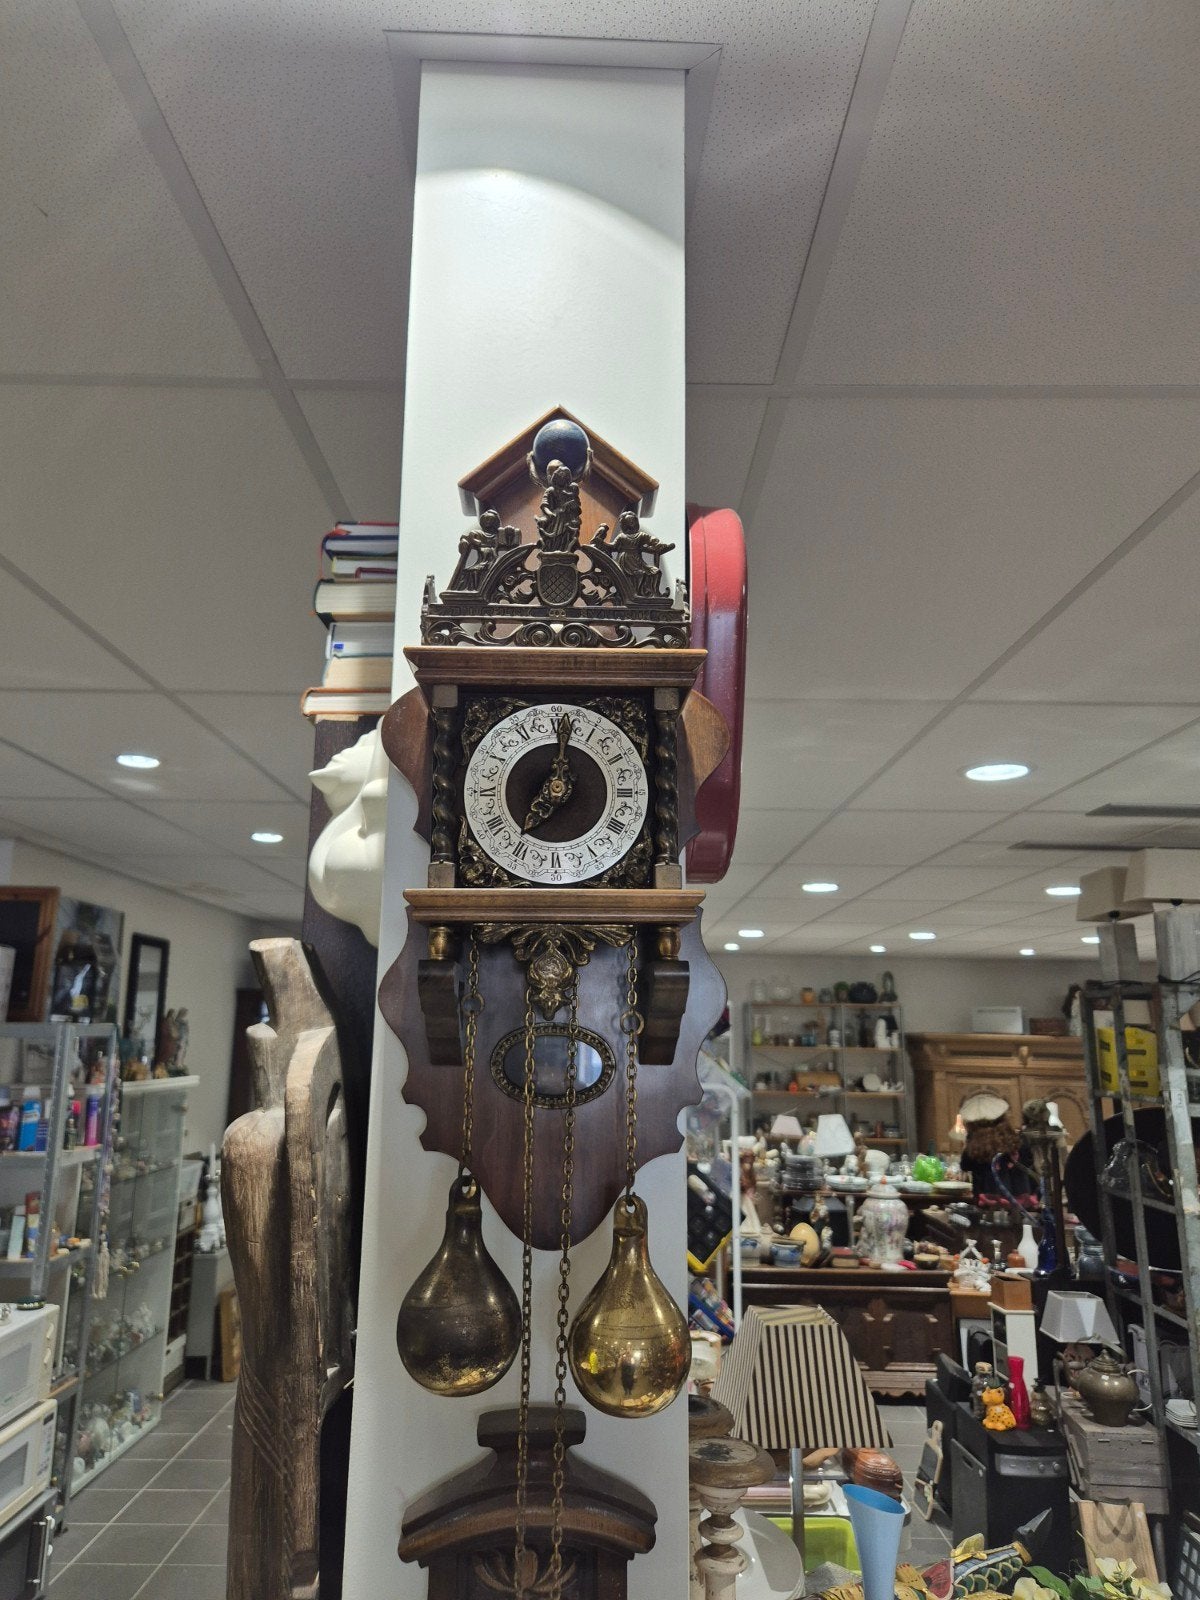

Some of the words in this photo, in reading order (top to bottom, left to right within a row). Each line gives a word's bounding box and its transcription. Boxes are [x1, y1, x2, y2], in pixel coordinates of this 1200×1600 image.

[551, 705, 562, 713] 60
[607, 754, 623, 765] II
[616, 788, 633, 798] III
[606, 816, 626, 835] IIII
[551, 874, 562, 882] 30
